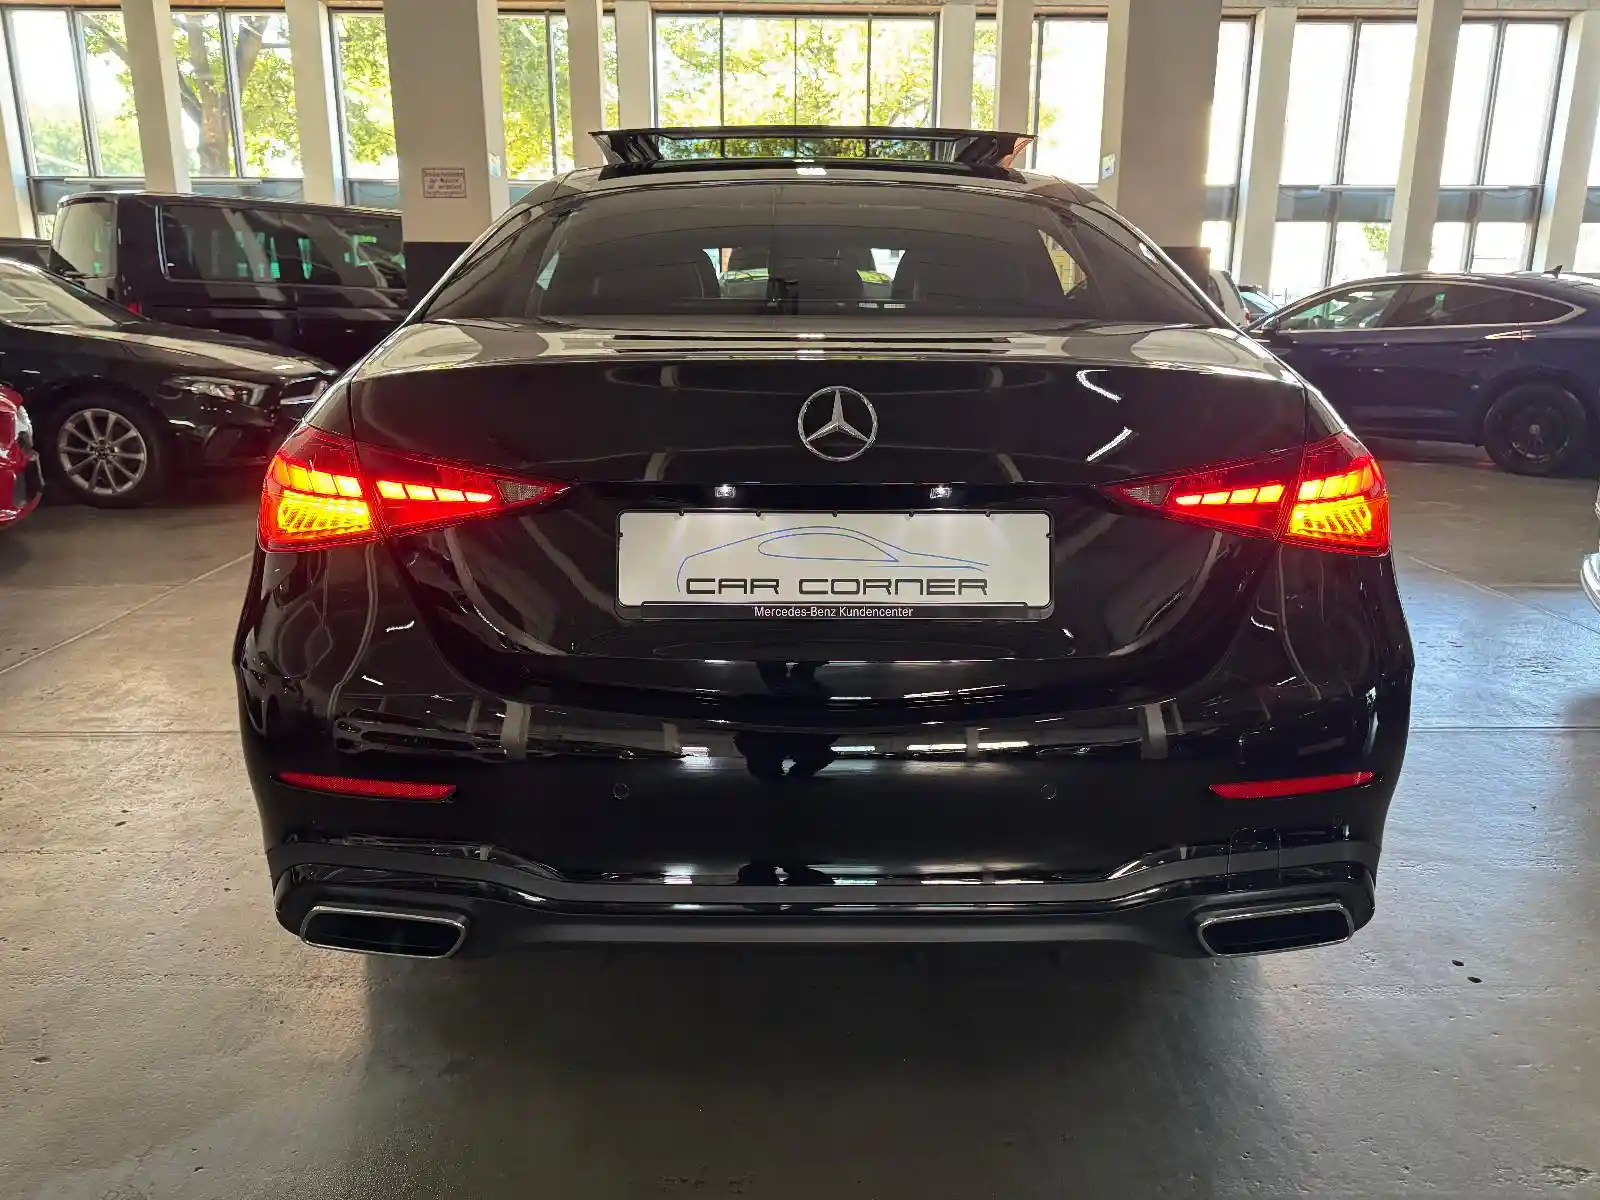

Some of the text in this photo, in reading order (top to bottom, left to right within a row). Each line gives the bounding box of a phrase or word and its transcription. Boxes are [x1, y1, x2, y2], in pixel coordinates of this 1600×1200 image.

[686, 578, 988, 595] CAR CORNER
[754, 606, 914, 618] Mercedes-Benz Kundencenter
